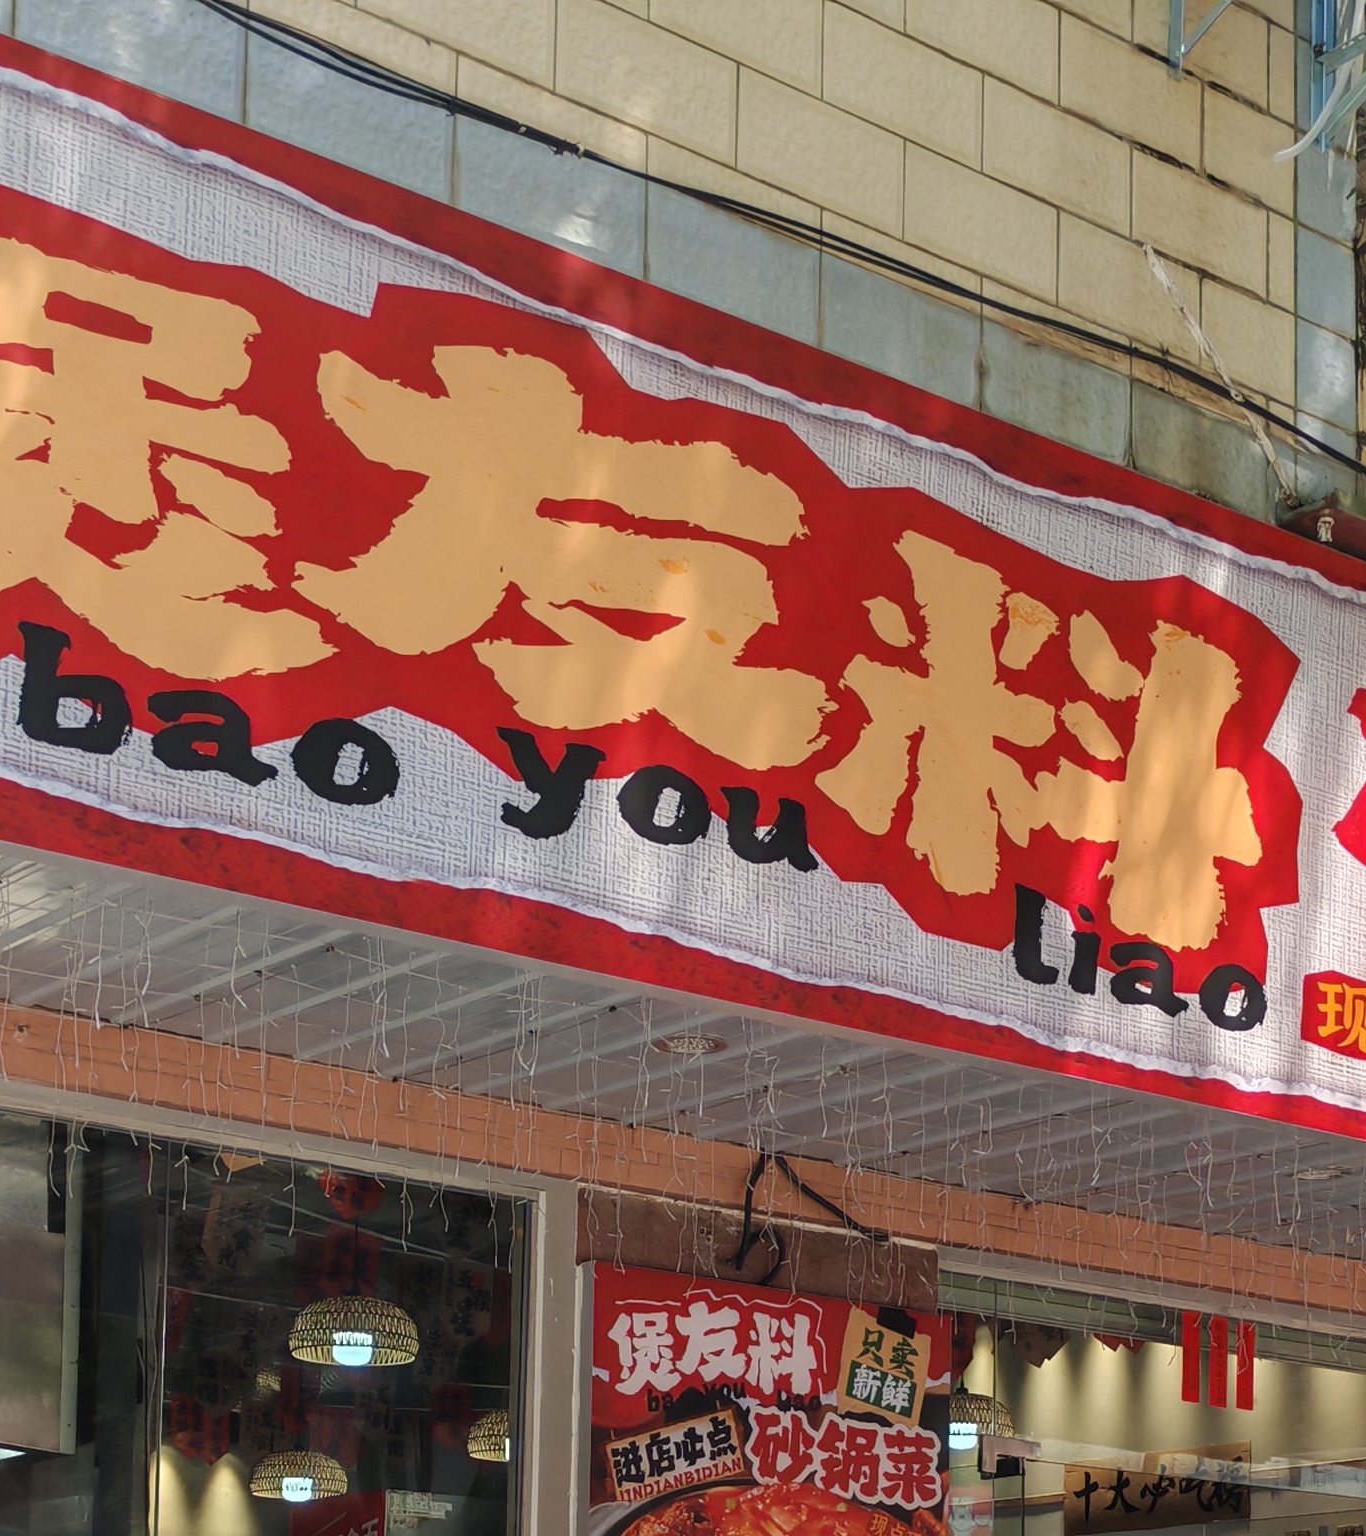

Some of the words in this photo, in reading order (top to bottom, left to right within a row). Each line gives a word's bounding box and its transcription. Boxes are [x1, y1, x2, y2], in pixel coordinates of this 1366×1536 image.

[16, 621, 399, 807] bao
[499, 725, 819, 872] you
[1011, 884, 1268, 1034] liao
[608, 1301, 817, 1395] 煲友料
[852, 1364, 911, 1411] 新鲜
[857, 1328, 919, 1377] 只卖
[612, 1416, 737, 1488] 进店必点
[754, 1415, 935, 1503] 砂锅菜
